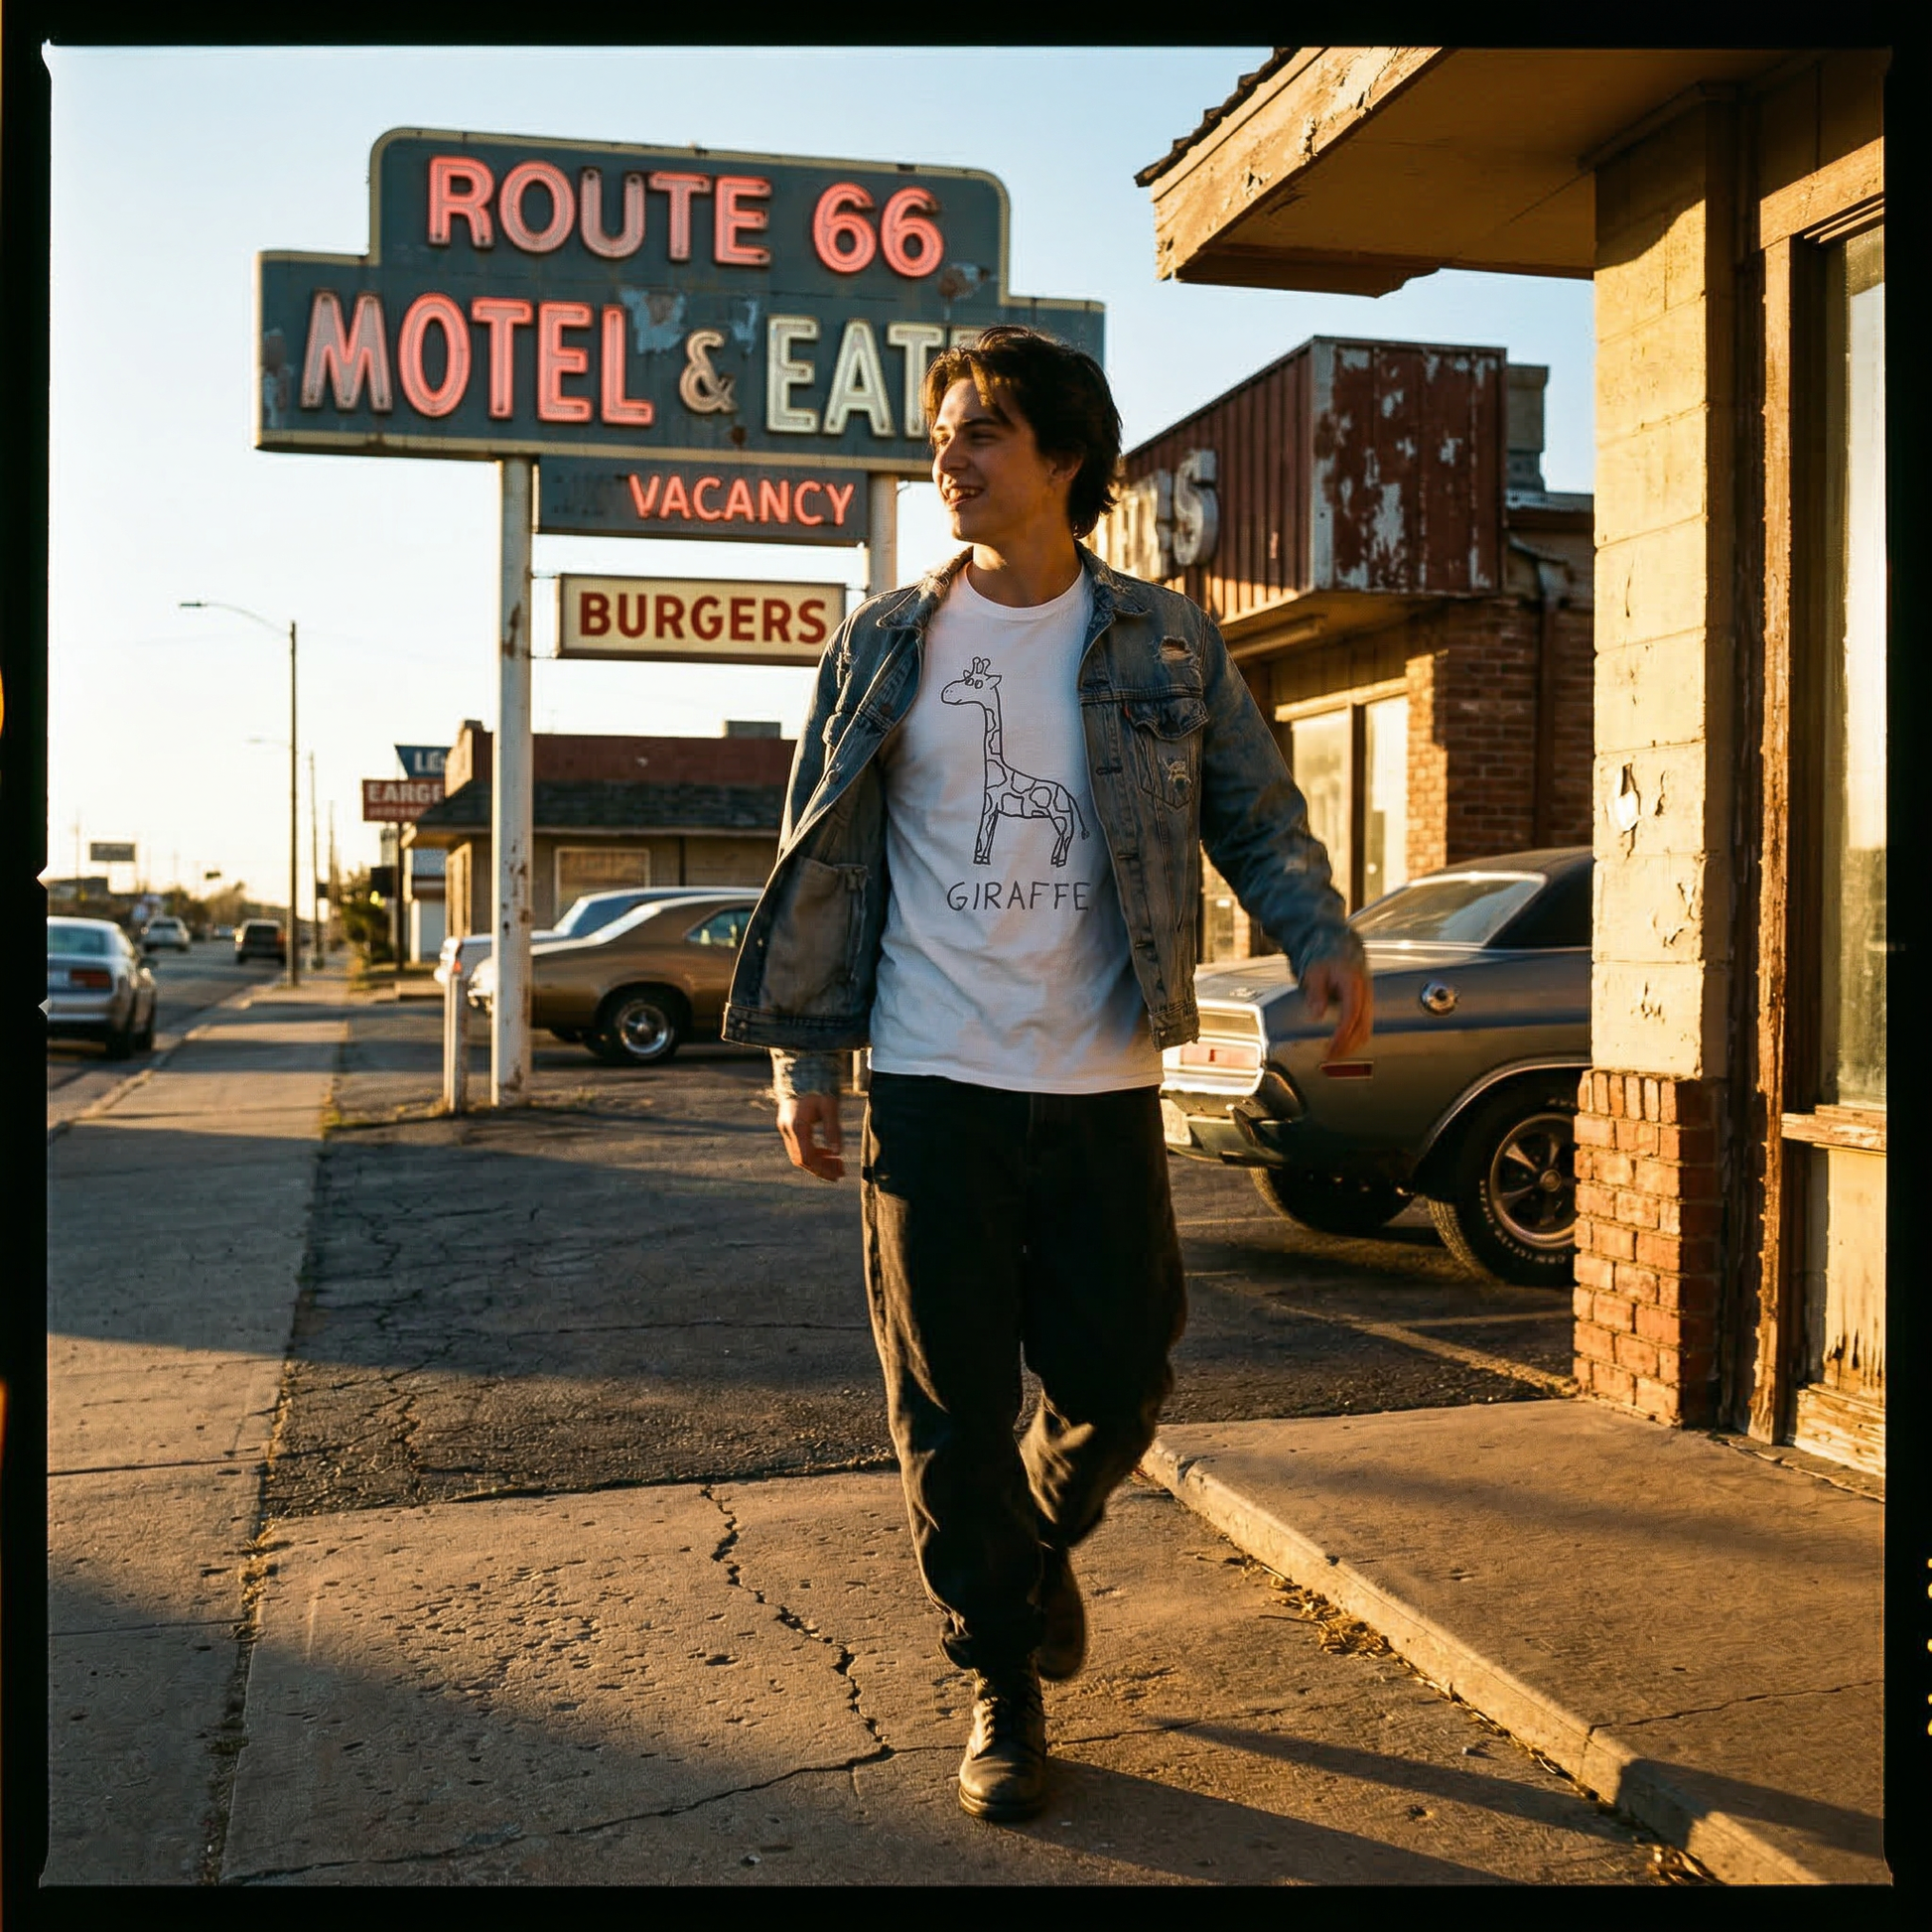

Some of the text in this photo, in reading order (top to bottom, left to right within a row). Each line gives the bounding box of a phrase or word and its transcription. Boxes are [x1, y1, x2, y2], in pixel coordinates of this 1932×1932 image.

[428, 155, 944, 278] ROUTE 66
[301, 289, 985, 439] MOTEL & EAT
[628, 474, 855, 527] VACANCY
[580, 592, 827, 644] BURGERS
[946, 880, 1091, 911] GIRAFFE
